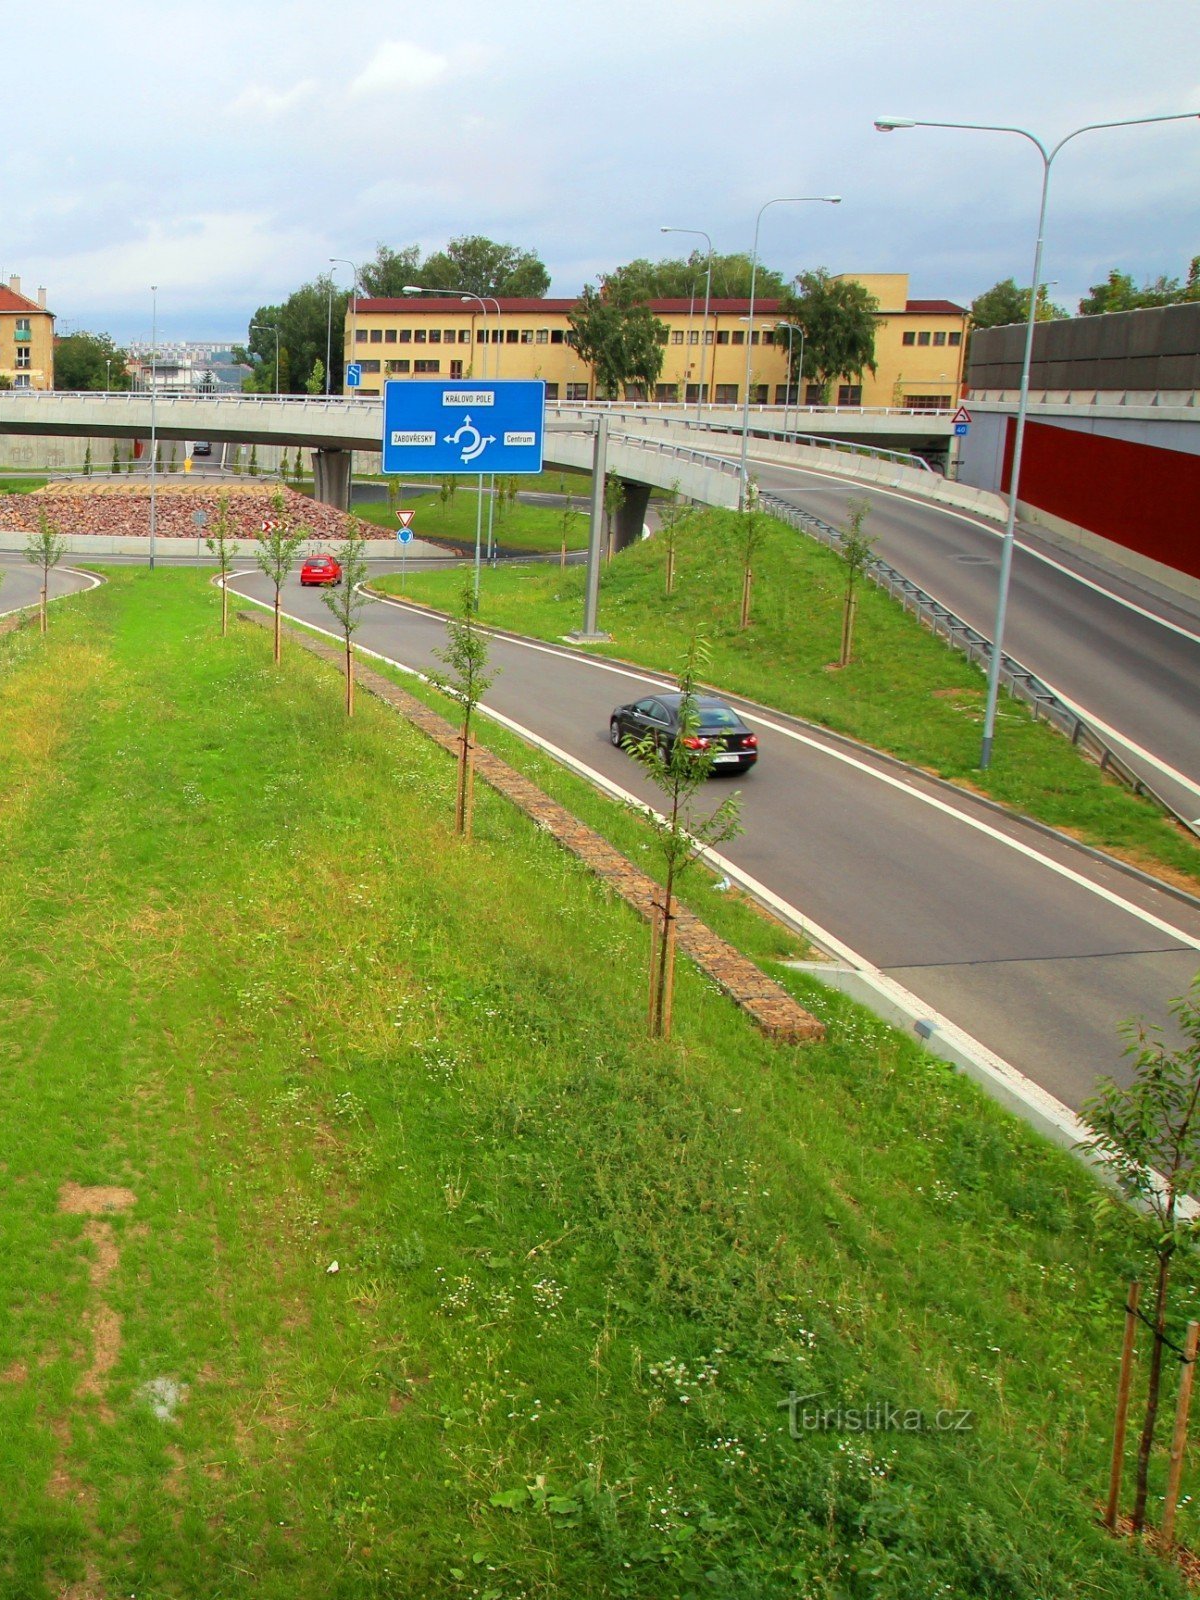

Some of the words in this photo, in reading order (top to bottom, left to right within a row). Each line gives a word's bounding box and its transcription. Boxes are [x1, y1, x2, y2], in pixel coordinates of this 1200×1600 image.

[445, 394, 474, 403] KRÁLOVO
[476, 395, 492, 403] POLE
[394, 434, 433, 443] ŽABOVŘESKY
[506, 434, 533, 443] Centrum
